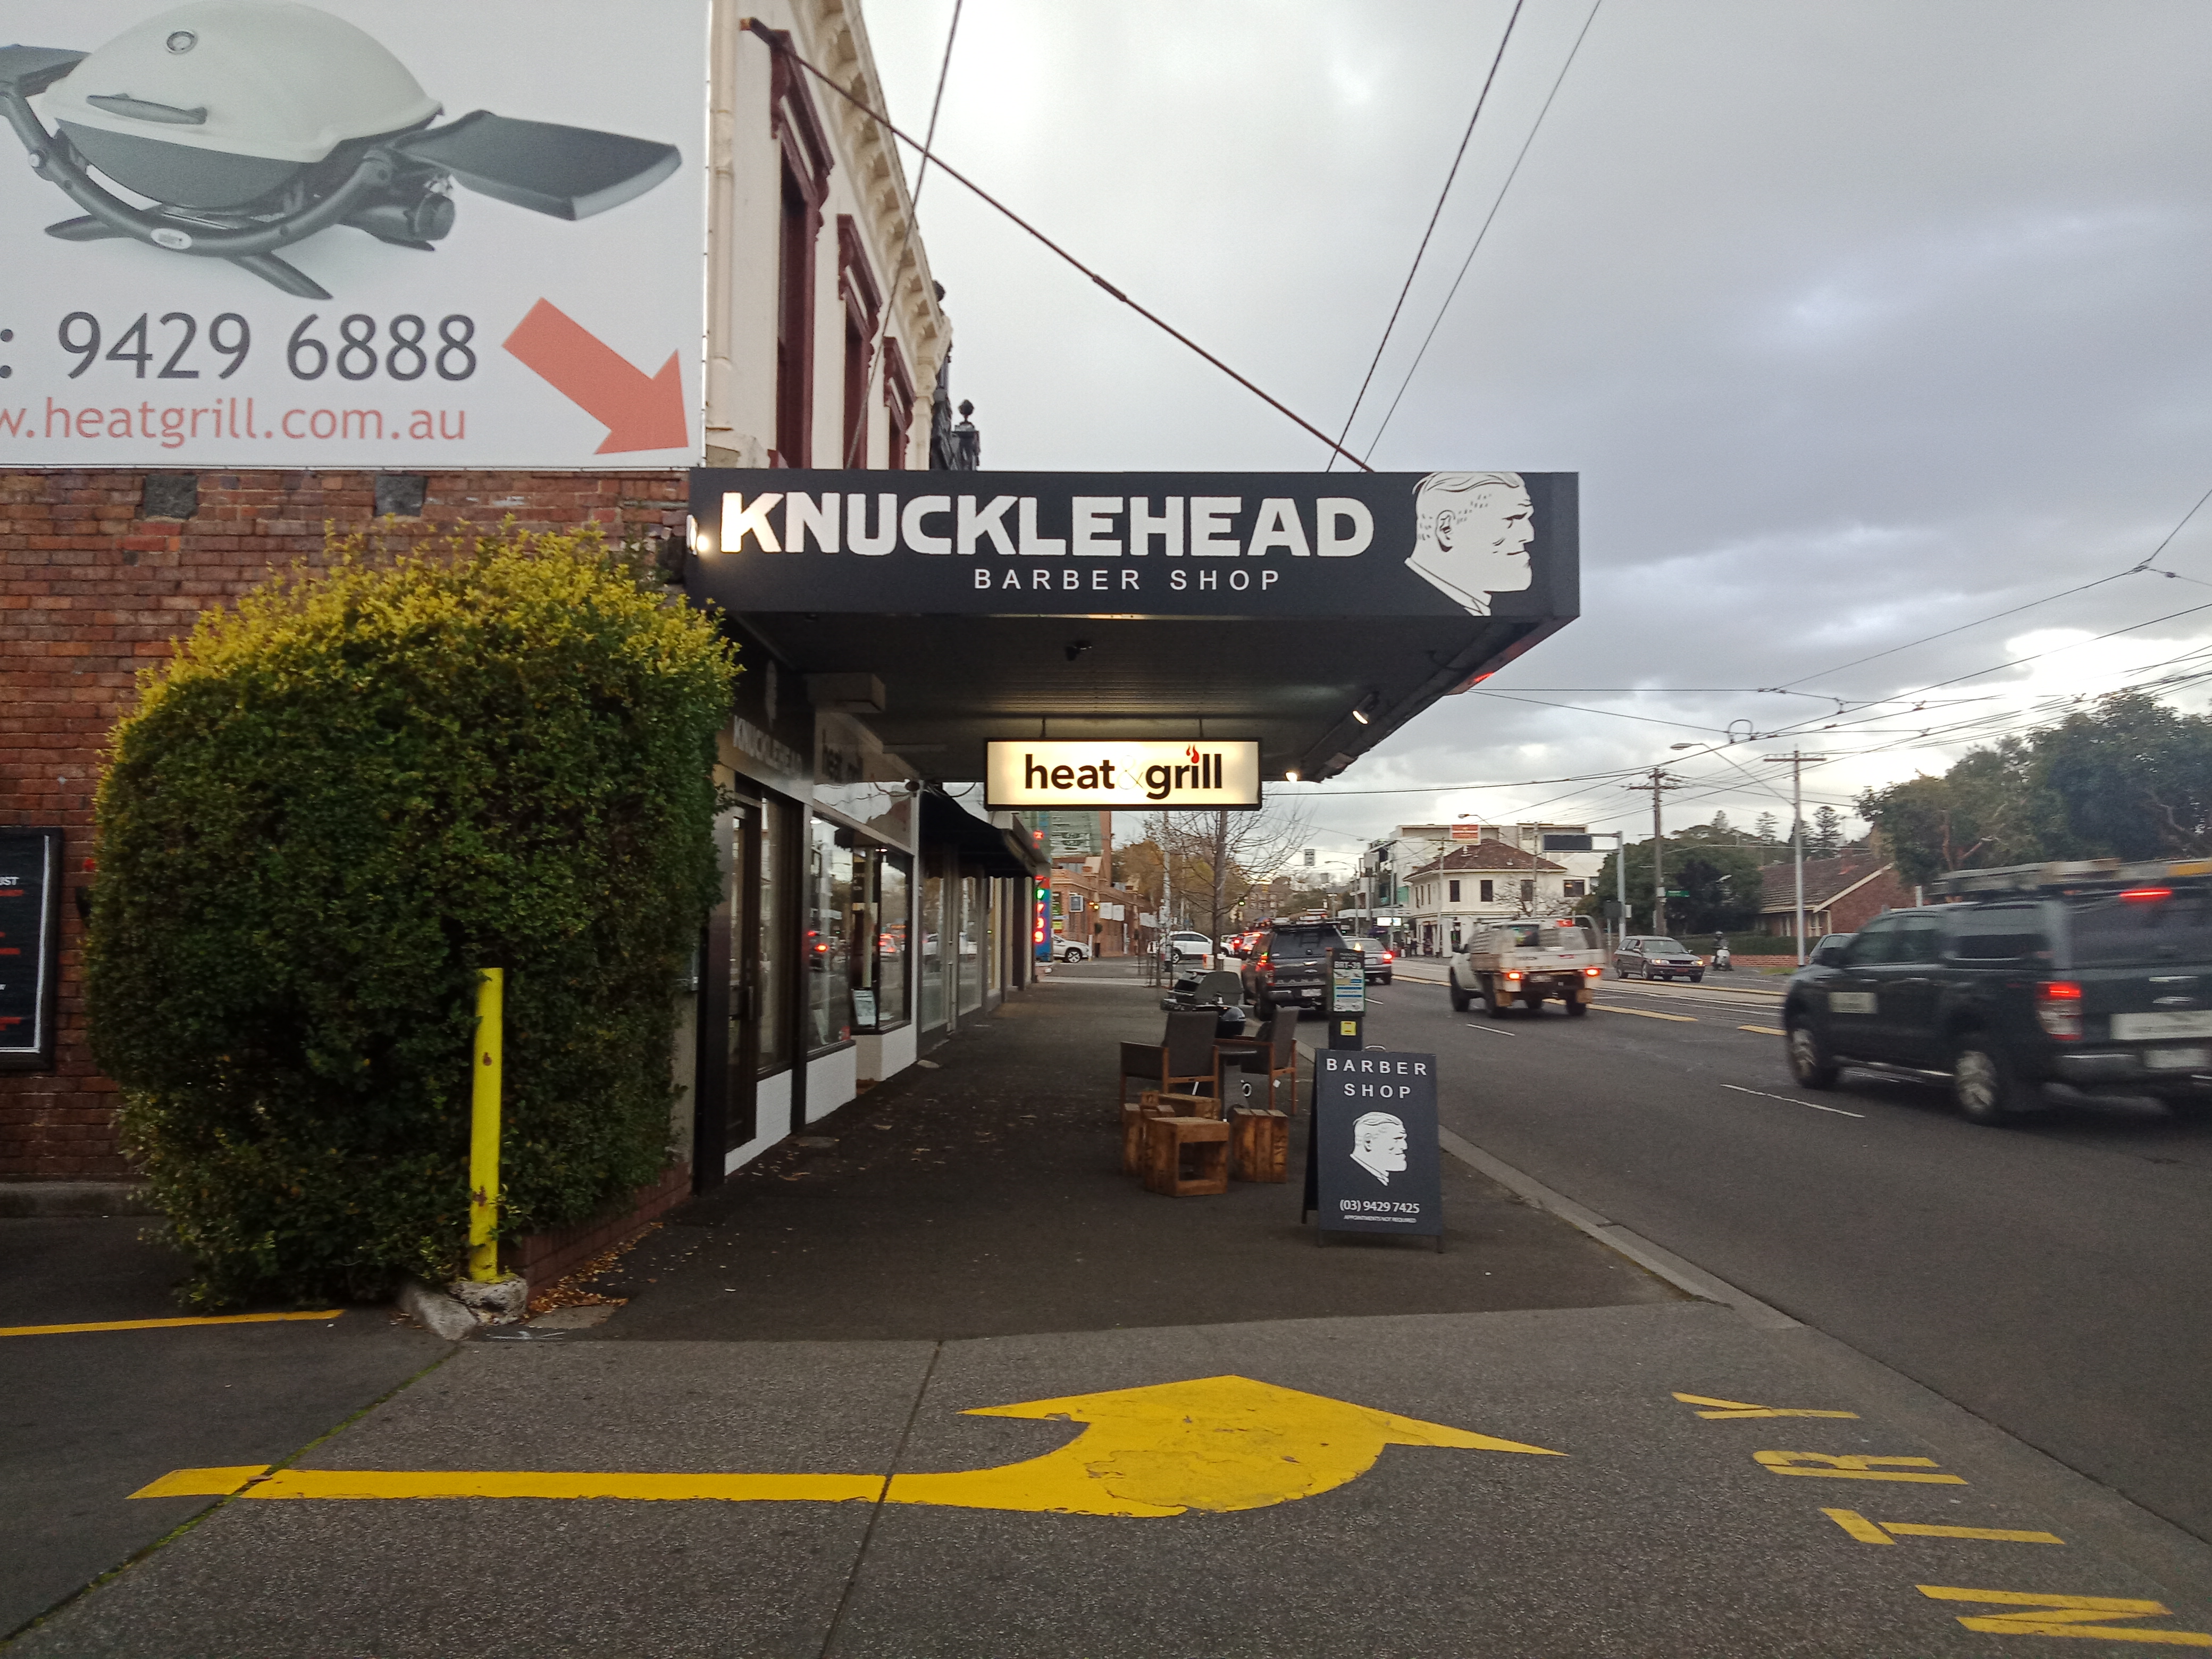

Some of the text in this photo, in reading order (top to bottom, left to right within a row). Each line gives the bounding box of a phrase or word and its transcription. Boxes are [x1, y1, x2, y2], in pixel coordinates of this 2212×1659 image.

[58, 311, 250, 379] 9429
[287, 313, 476, 381] 6888
[720, 491, 1375, 557] KNUCKLEHEAD
[974, 568, 1279, 591] BARBER SHOP
[1326, 1058, 1427, 1076] BARBER
[1344, 1083, 1411, 1099] SHOP
[1339, 1199, 1420, 1214] (03) 9429 7425
